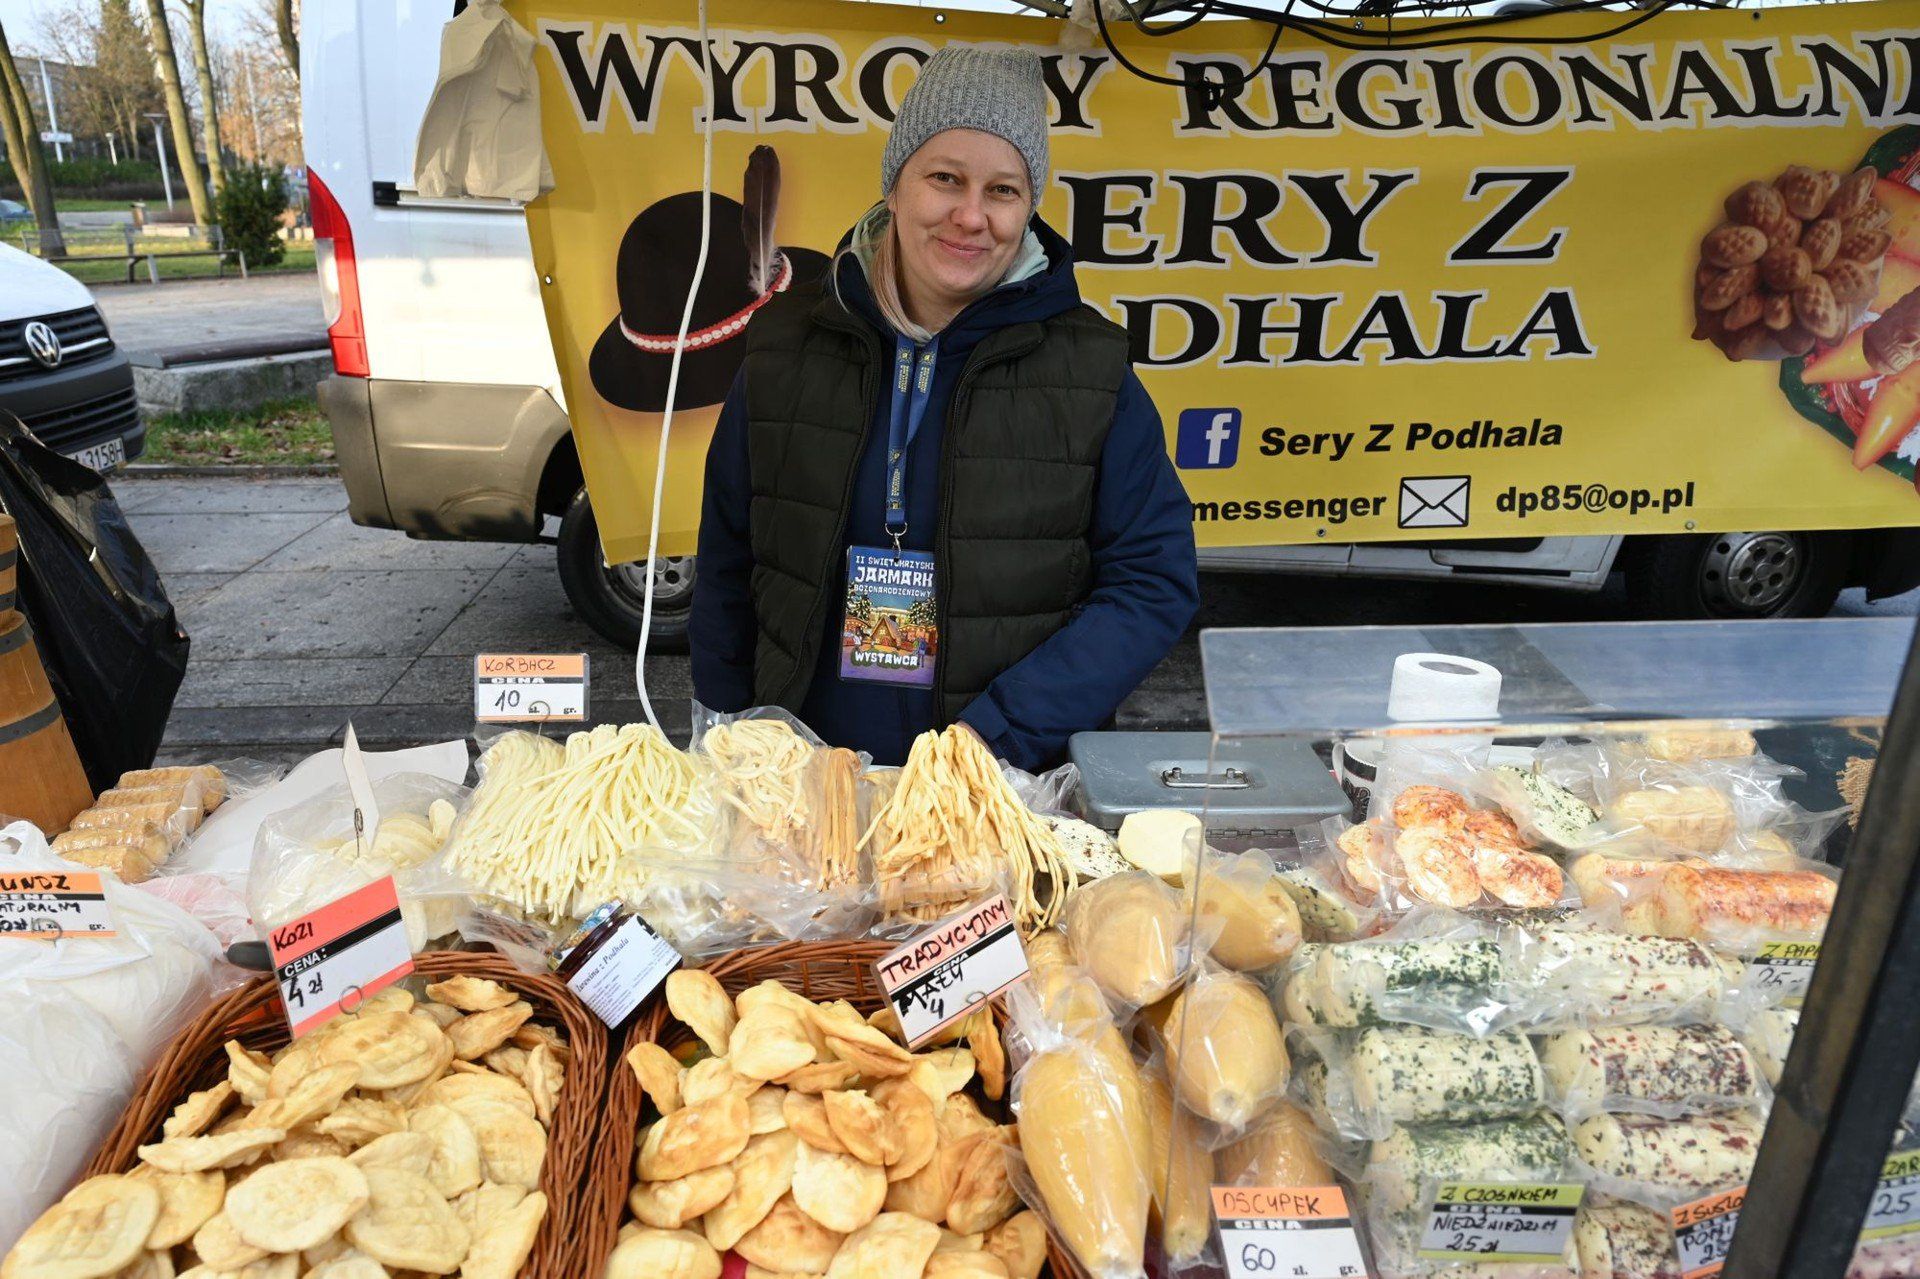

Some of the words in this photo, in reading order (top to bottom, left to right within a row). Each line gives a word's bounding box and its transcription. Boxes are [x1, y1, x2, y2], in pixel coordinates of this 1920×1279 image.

[546, 29, 1109, 129] WYROY
[1058, 173, 1412, 265] ERY
[1450, 172, 1570, 260] Z
[1116, 292, 1592, 365] DHALA
[1260, 427, 1355, 461] Sery
[1364, 424, 1395, 452] Z
[1405, 418, 1563, 451] Podhala
[1191, 493, 1386, 524] messenger
[1496, 482, 1695, 519] dp85@op.pl
[855, 566, 934, 588] JARMARK
[855, 651, 919, 666] WYSTAWCA
[495, 690, 520, 712] 10
[0, 875, 70, 891] UNDZ
[0, 902, 81, 914] ATURALNY
[285, 948, 327, 977] CENA:
[288, 975, 304, 1008] 4
[929, 998, 945, 1019] 4
[1886, 1155, 1920, 1176] ZAR
[1441, 1187, 1457, 1200] Z
[1874, 1190, 1917, 1217] 25
[1693, 1196, 1744, 1220] SUSZO
[1235, 1220, 1302, 1230] CENA
[1683, 1224, 1732, 1252] POMI
[1242, 1243, 1276, 1272] 60
